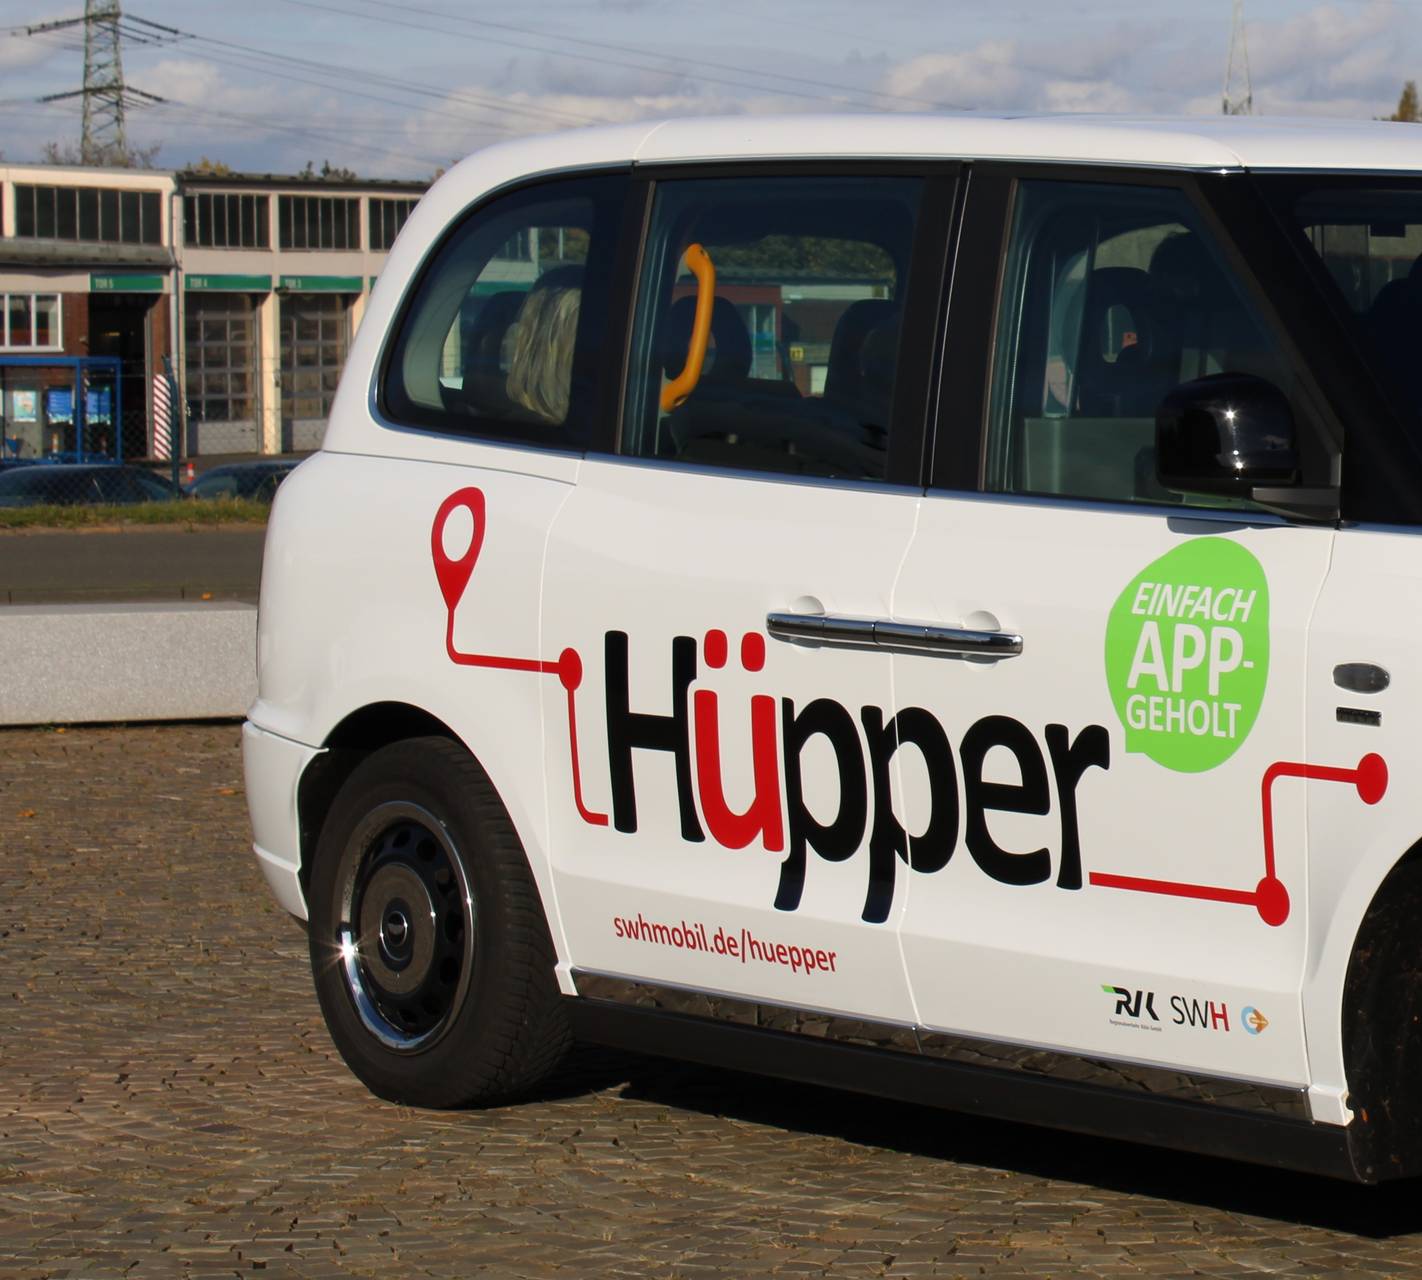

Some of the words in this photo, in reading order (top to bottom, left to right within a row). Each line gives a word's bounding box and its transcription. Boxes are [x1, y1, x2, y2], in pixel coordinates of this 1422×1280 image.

[1131, 582, 1257, 623] EINFACH
[1127, 620, 1254, 696] APP-
[1125, 694, 1242, 739] GEHOLT
[604, 629, 1110, 924] Hüpper
[614, 913, 837, 974] swhmobil.de/huepper
[1170, 995, 1230, 1032] SWH
